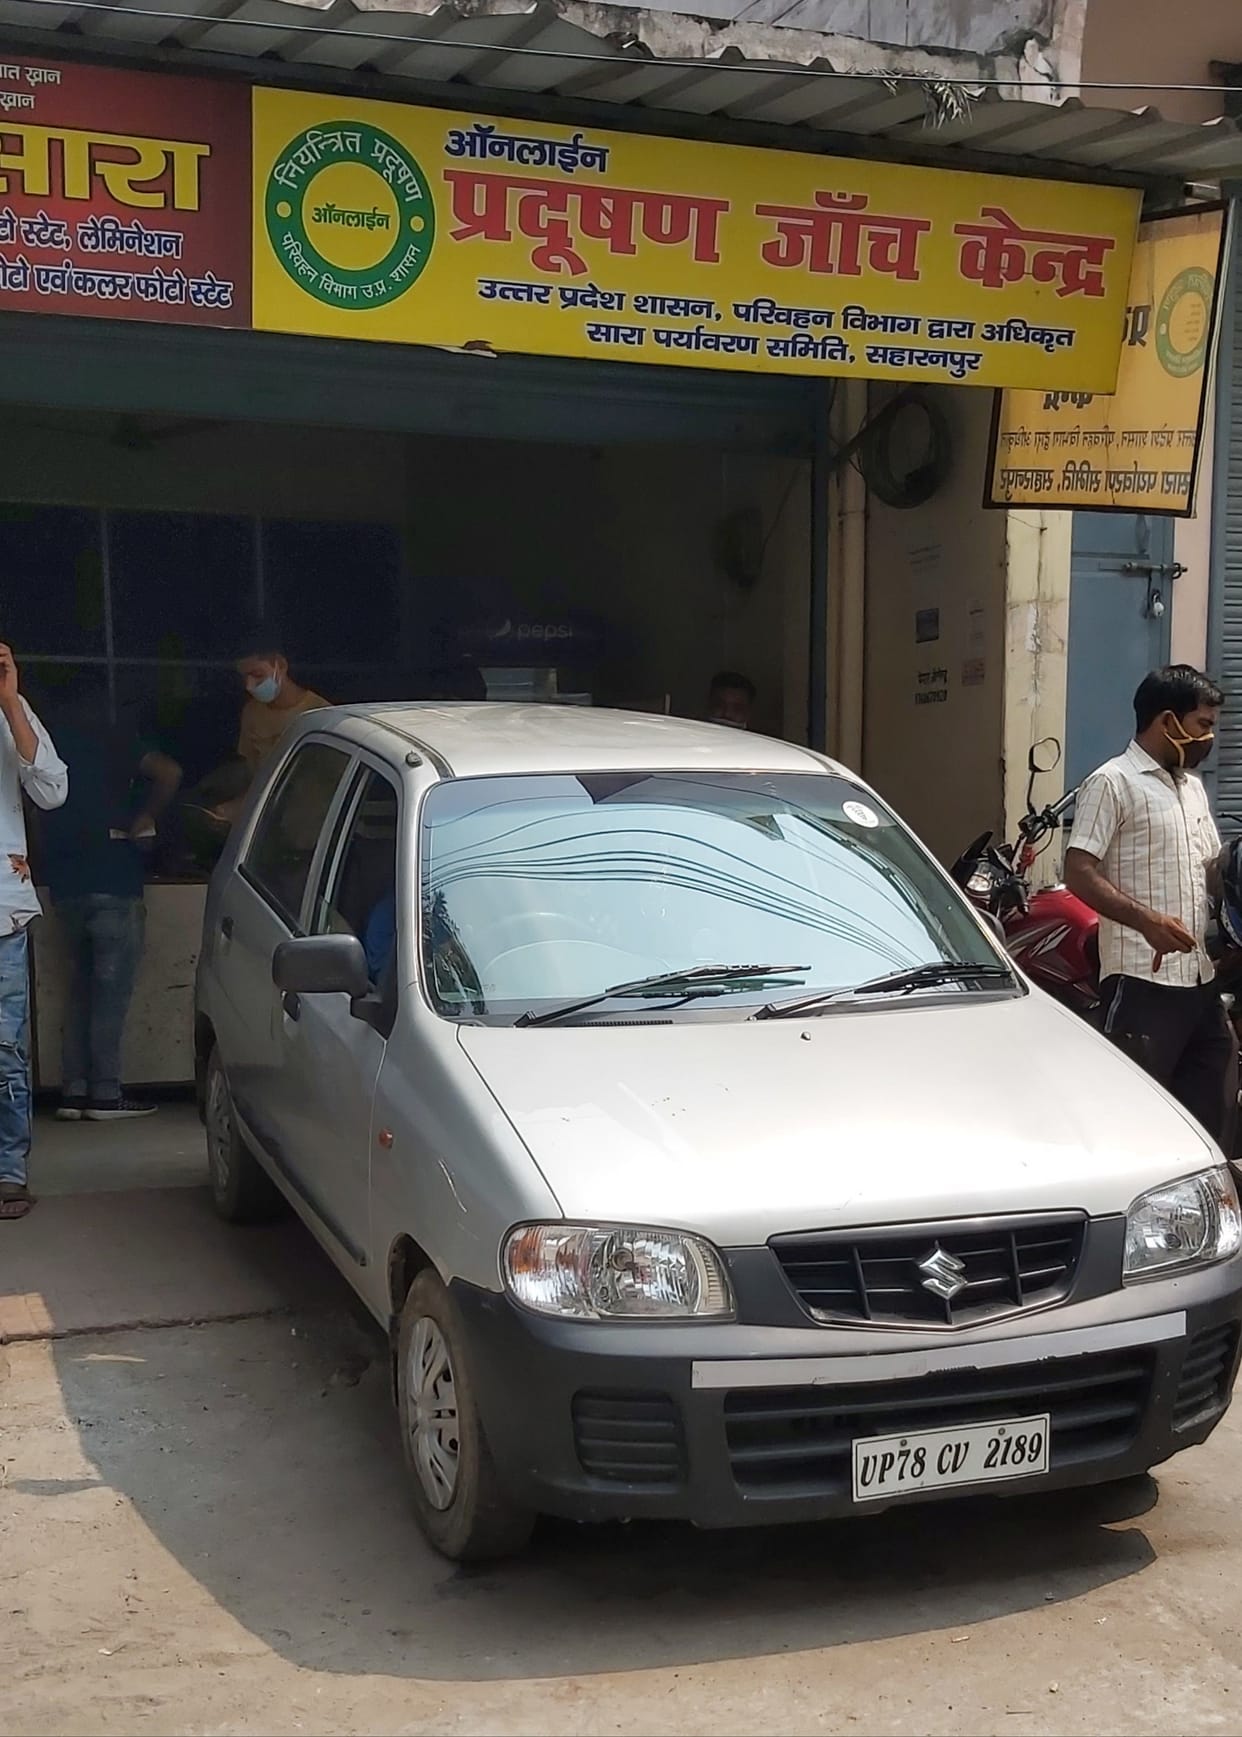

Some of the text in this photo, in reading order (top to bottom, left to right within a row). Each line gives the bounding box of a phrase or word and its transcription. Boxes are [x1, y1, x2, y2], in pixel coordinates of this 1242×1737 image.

[370, 138, 423, 202] प्रदूषण
[442, 123, 611, 174] ऑनलाईन
[20, 210, 72, 251] स्टेट,
[77, 214, 183, 259] लेमिनेशन
[312, 202, 391, 231] ऑनलाईन
[443, 168, 731, 277] प्रदूषण
[754, 190, 932, 281] जाँच
[953, 206, 1116, 298] केन्द्र
[33, 259, 72, 294] एवं
[73, 269, 134, 300] कलर
[134, 266, 186, 303] फोटो
[189, 271, 233, 309] स्टेट
[281, 231, 319, 284] परिवहन
[389, 243, 422, 283] शासन
[477, 278, 1076, 353] उत्तर प्रदेश शासन, परिवहन विभाग द्वारा अधिकृत
[585, 322, 983, 378] सारा पर्यावरण समिति, सहारनपुर
[860, 1432, 1042, 1487] UP78 CV 2189
